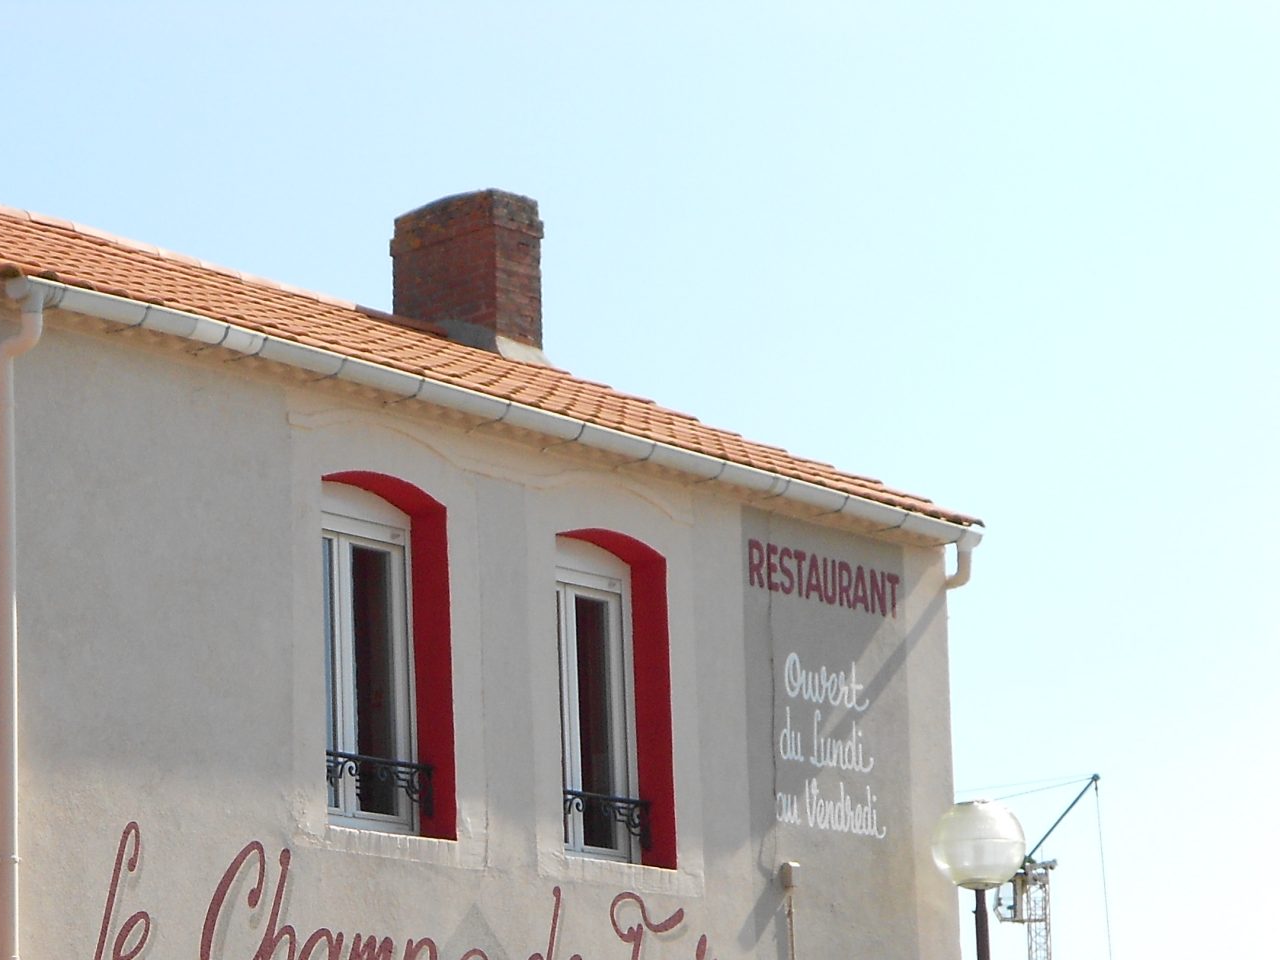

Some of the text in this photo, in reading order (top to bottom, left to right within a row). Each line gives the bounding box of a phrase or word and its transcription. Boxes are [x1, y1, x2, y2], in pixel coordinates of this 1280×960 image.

[748, 538, 900, 618] RESTAURANT
[785, 652, 869, 711] Ouvert
[780, 707, 874, 773] du Lundi
[777, 777, 886, 839] au Vendredi
